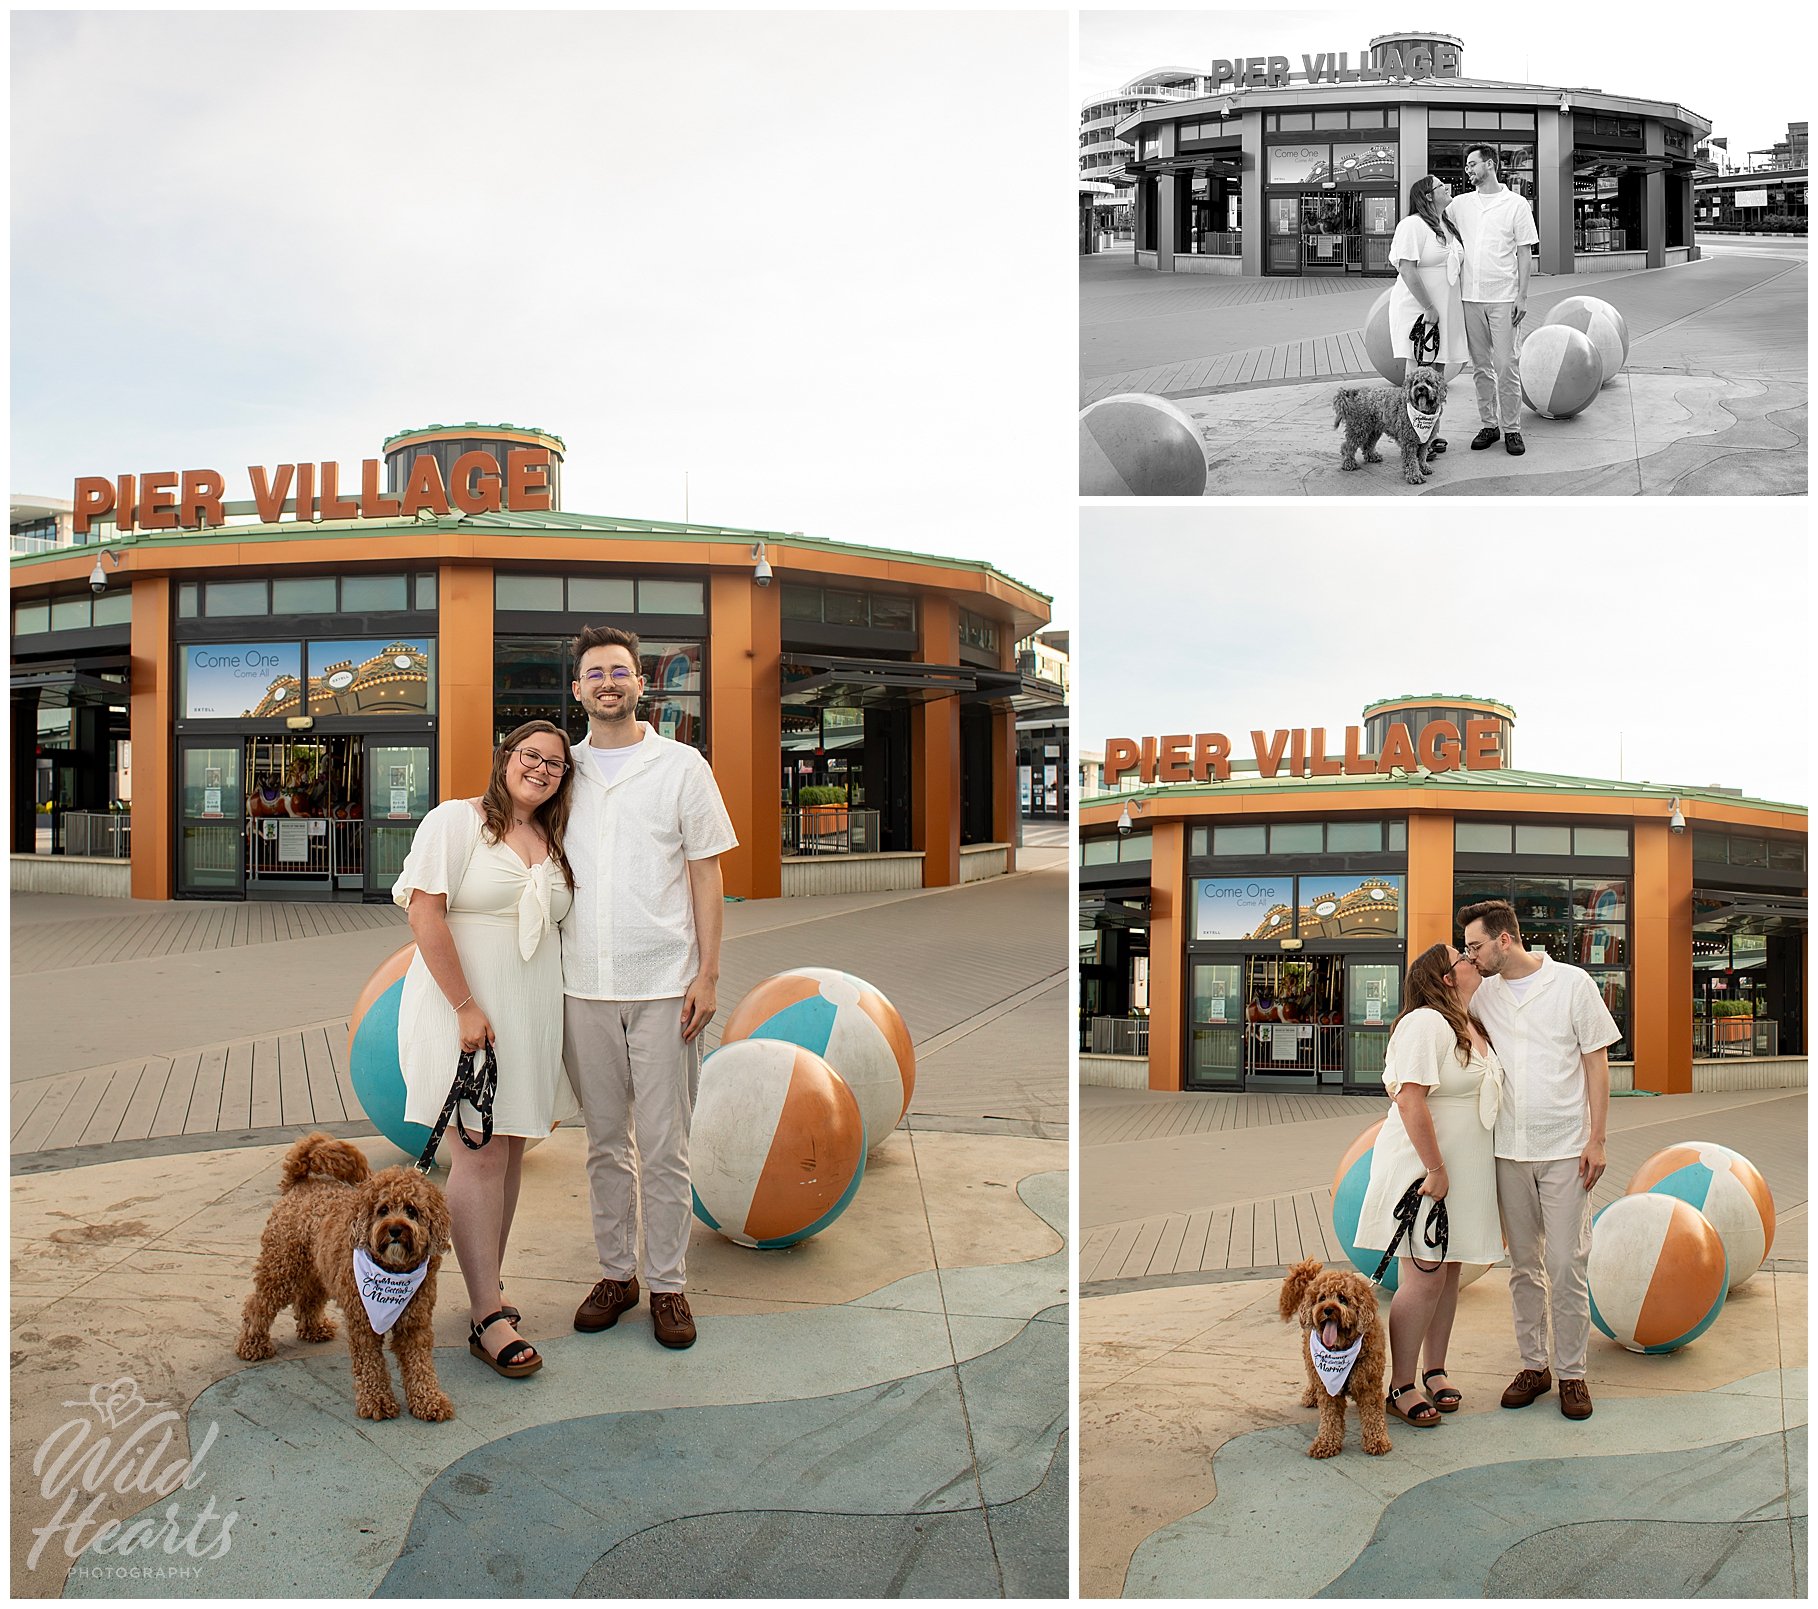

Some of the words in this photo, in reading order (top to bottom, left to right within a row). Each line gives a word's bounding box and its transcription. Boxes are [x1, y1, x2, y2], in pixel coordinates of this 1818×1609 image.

[1211, 55, 1290, 89] PIER
[1302, 46, 1457, 84] VILLAGE
[1274, 149, 1298, 158] Come
[1300, 148, 1318, 158] One
[73, 469, 225, 533] PIER
[247, 449, 551, 524] VILLAGE
[195, 651, 240, 668] Come
[245, 650, 279, 667] One
[233, 669, 257, 678] Come
[259, 669, 270, 677] All
[1104, 733, 1231, 785] PIER
[1250, 719, 1503, 777] VILLAGE
[1204, 883, 1243, 898] Come
[1246, 883, 1275, 898] One
[1236, 899, 1256, 907] Come
[1258, 898, 1267, 906] All
